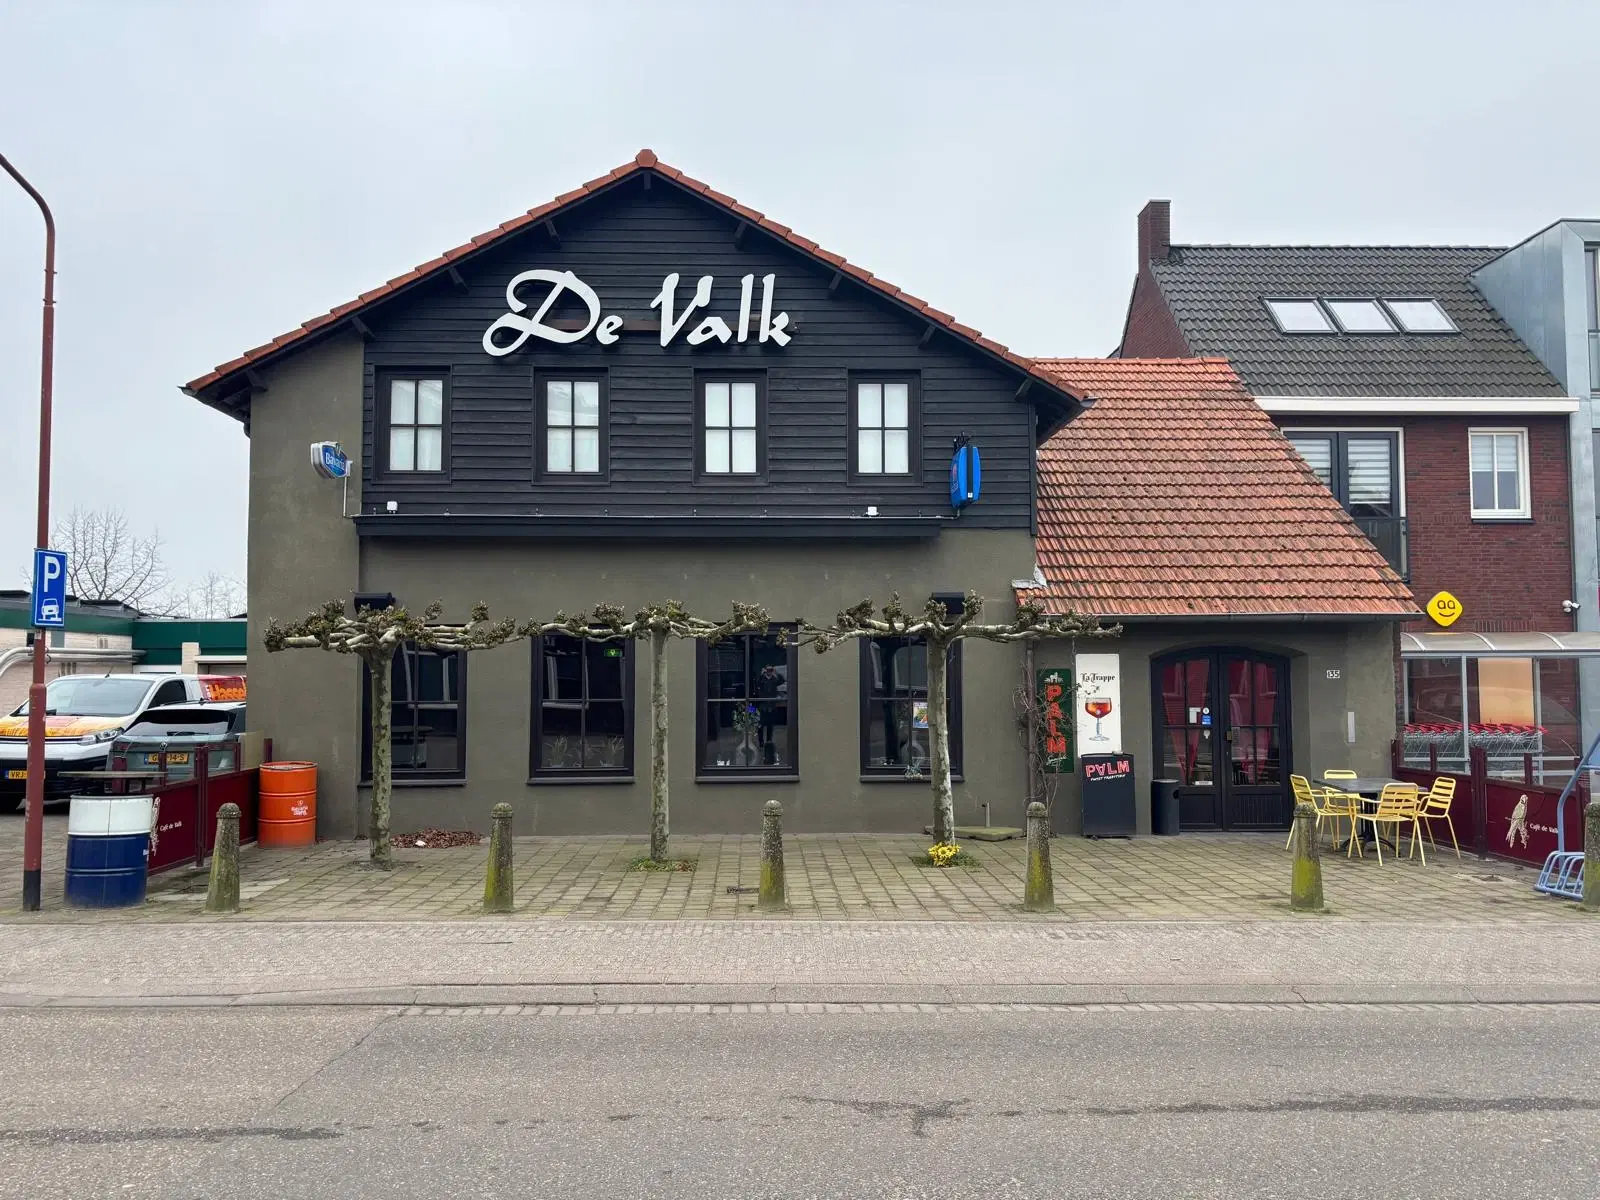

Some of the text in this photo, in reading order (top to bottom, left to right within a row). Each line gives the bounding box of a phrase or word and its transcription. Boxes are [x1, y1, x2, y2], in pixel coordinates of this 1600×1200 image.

[482, 269, 793, 357] De Valk
[43, 555, 61, 593] P
[1081, 671, 1116, 683] La Trappe
[1045, 684, 1067, 754] PALM
